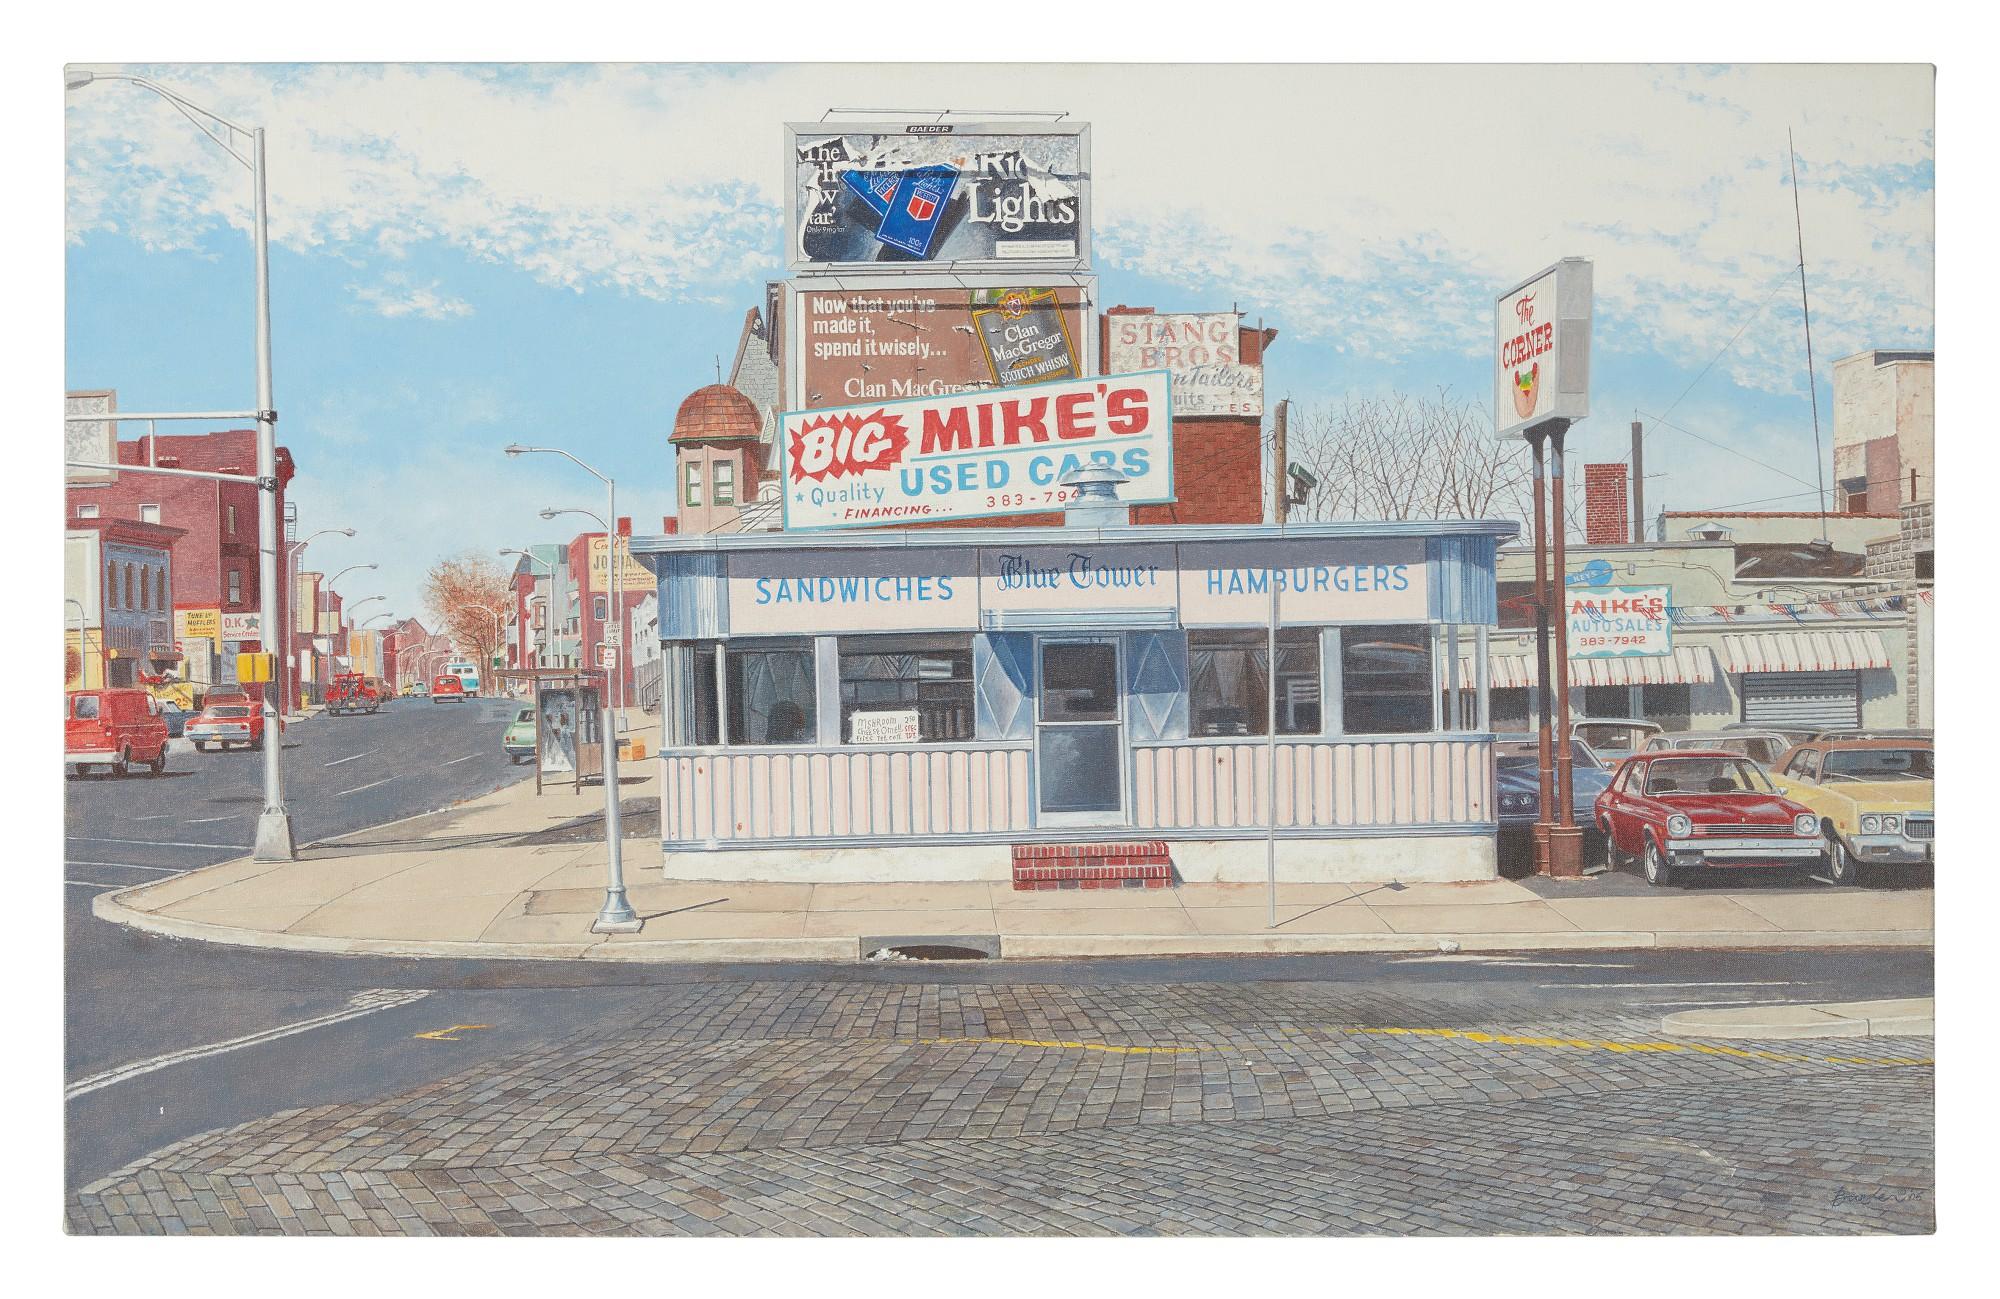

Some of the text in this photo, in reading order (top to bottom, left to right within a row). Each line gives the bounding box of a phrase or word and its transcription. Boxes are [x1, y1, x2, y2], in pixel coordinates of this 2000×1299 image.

[813, 295, 936, 319] Now that you've
[1515, 291, 1537, 327] The
[813, 316, 876, 336] made it,
[1004, 324, 1039, 342] Clan
[1120, 320, 1229, 345] STANG
[814, 335, 947, 360] spend it wisely...
[991, 332, 1062, 362] MacGregor
[1140, 345, 1236, 369] BROS
[1502, 321, 1553, 370] CORNER
[1000, 365, 1036, 383] SCOTCH
[844, 378, 887, 397] Clan
[801, 383, 1150, 473] BIG MIKE'S
[900, 460, 1010, 497] USED
[811, 482, 885, 507] Quality
[845, 504, 953, 519] FINANCING...
[996, 552, 1159, 591] Blue Tower
[1207, 564, 1409, 594] HAMBURGERS
[756, 575, 954, 604] SANDWICHES
[1571, 594, 1663, 614] MIKE'S
[1572, 617, 1662, 633] AUTO SALES
[1580, 635, 1647, 646] 383-7942
